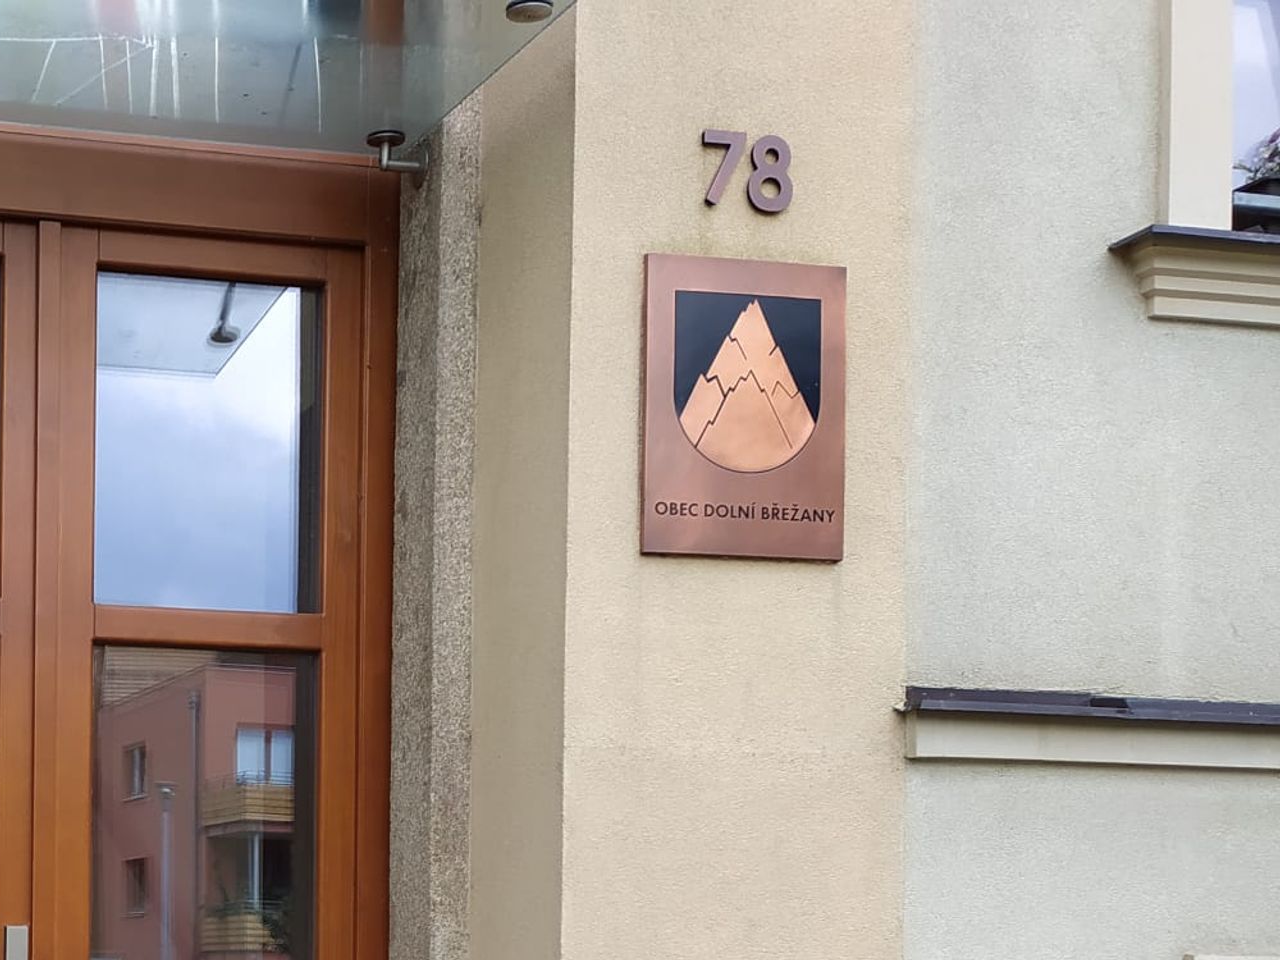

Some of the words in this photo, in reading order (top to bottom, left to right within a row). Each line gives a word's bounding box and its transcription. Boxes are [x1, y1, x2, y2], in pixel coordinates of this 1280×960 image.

[701, 128, 793, 214] 78
[655, 501, 699, 518] OBEC
[704, 502, 757, 520] DOLNÍ
[760, 503, 835, 523] BŘEŽANY
